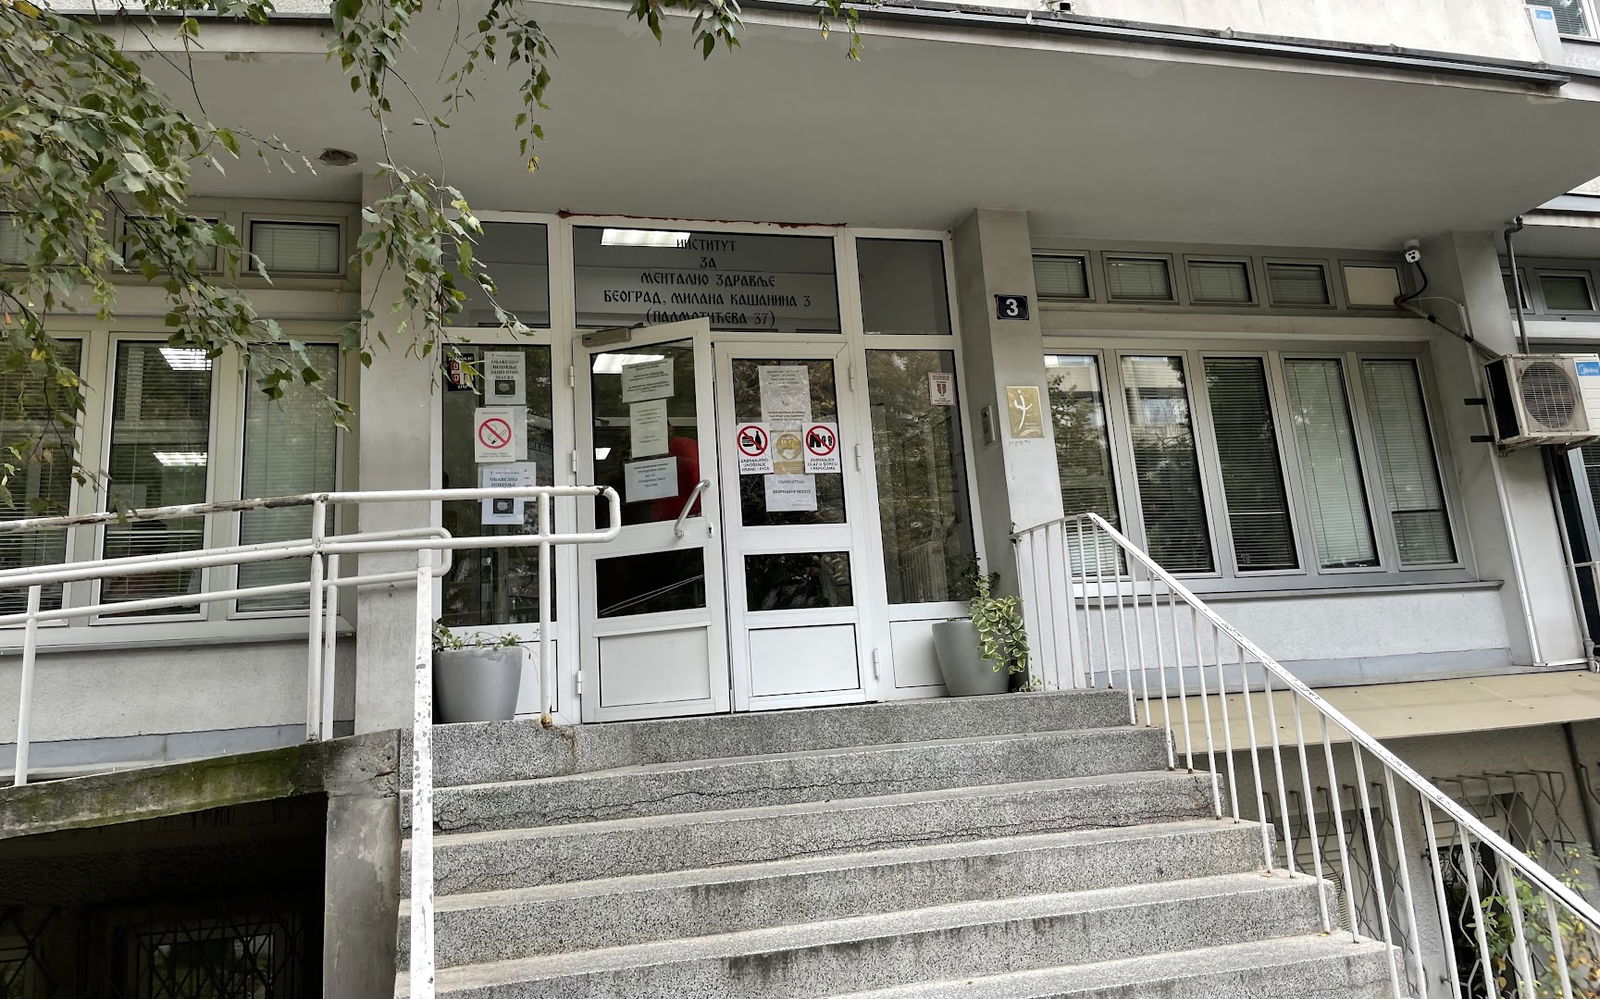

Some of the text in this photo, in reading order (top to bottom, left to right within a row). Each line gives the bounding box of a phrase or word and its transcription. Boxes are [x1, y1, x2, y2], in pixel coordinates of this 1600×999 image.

[676, 238, 737, 252] ИНСТИТУТ
[700, 256, 717, 269] ЗА
[640, 272, 776, 288] МЕНТАЛНО ЗДРАВЉЕ
[603, 289, 812, 308] БЕОГРАД, МИЛАНА КАШАНИНА 3
[1006, 298, 1019, 317] 3
[754, 311, 776, 329] 37)
